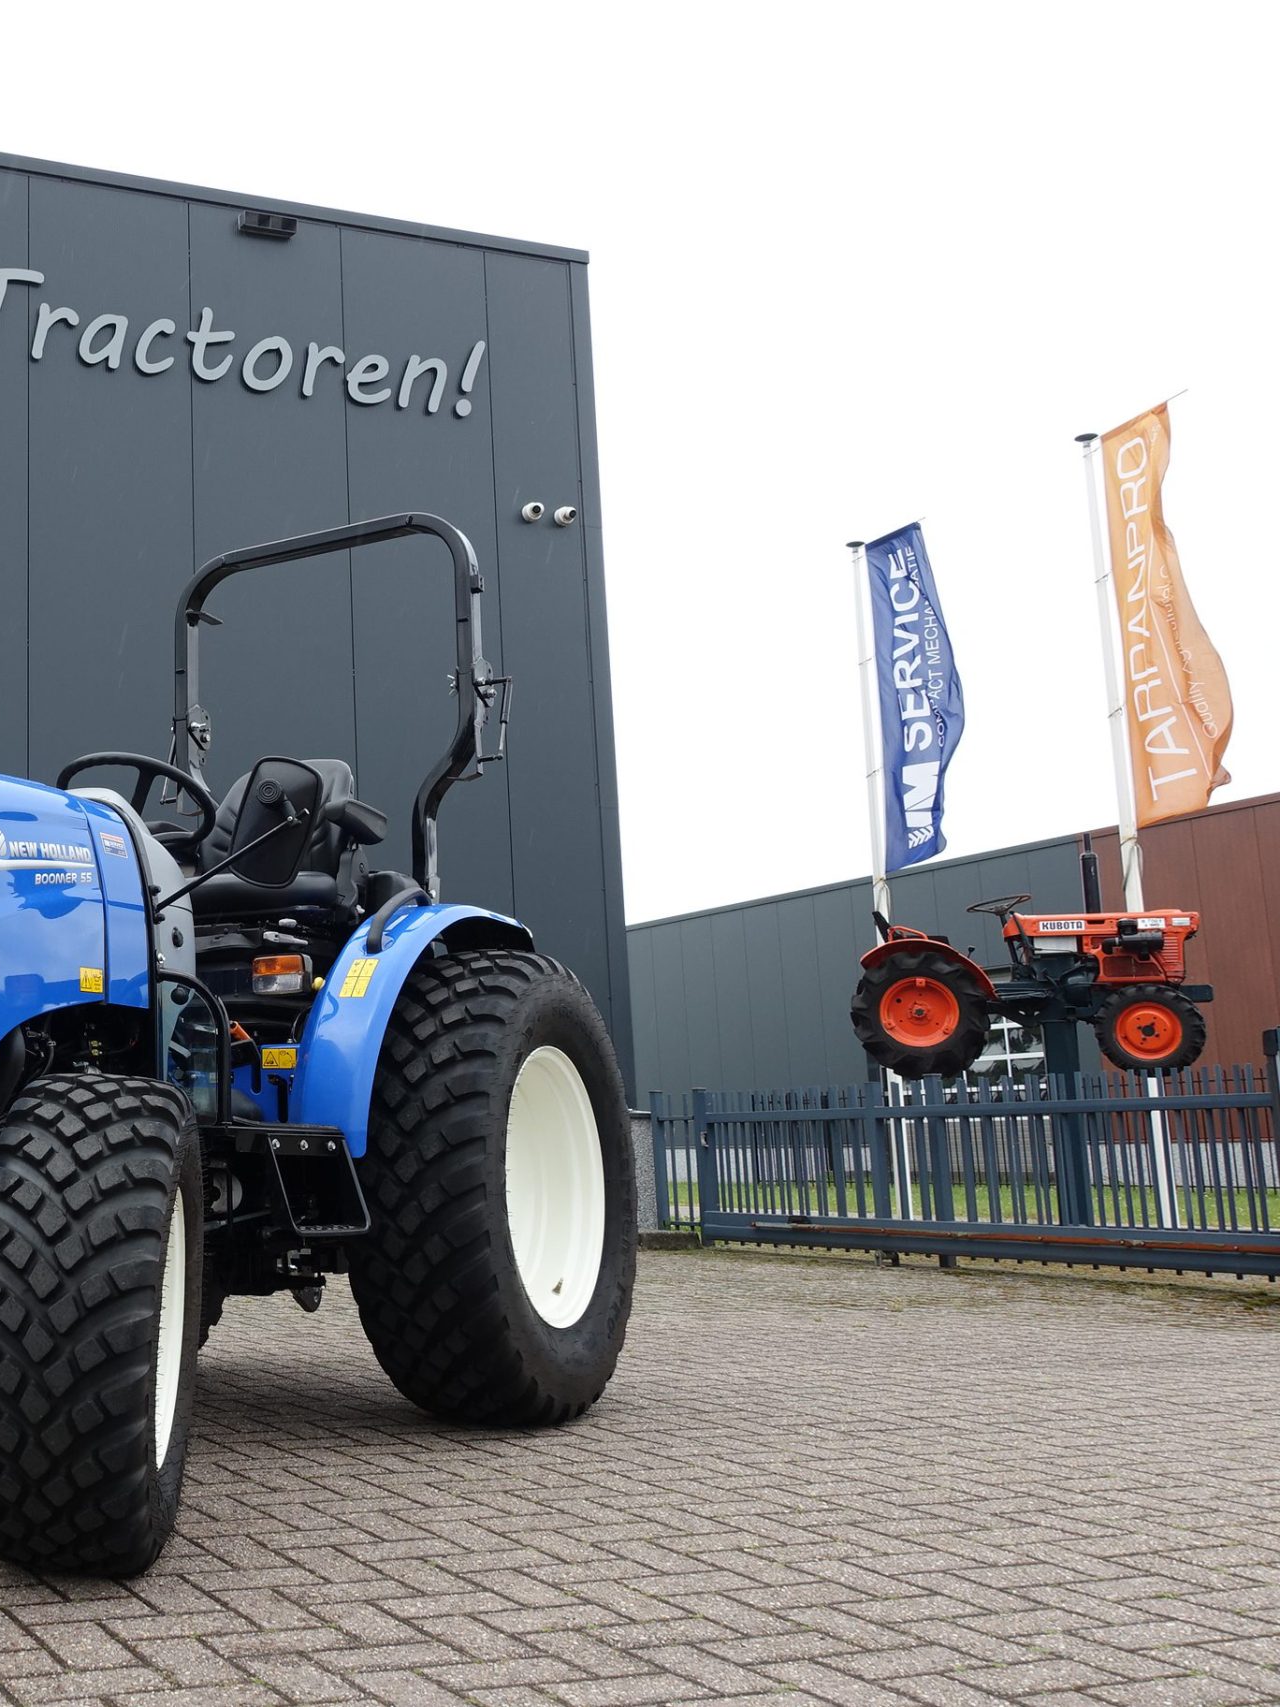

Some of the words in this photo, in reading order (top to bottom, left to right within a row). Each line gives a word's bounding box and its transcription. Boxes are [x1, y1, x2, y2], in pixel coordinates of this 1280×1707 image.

[888, 549, 933, 752] SERVICE
[9, 841, 38, 858] NEW
[40, 843, 92, 862] HOLLAND
[35, 872, 77, 885] BOOMER
[80, 871, 92, 883] 55
[1042, 921, 1083, 930] KUBOTA
